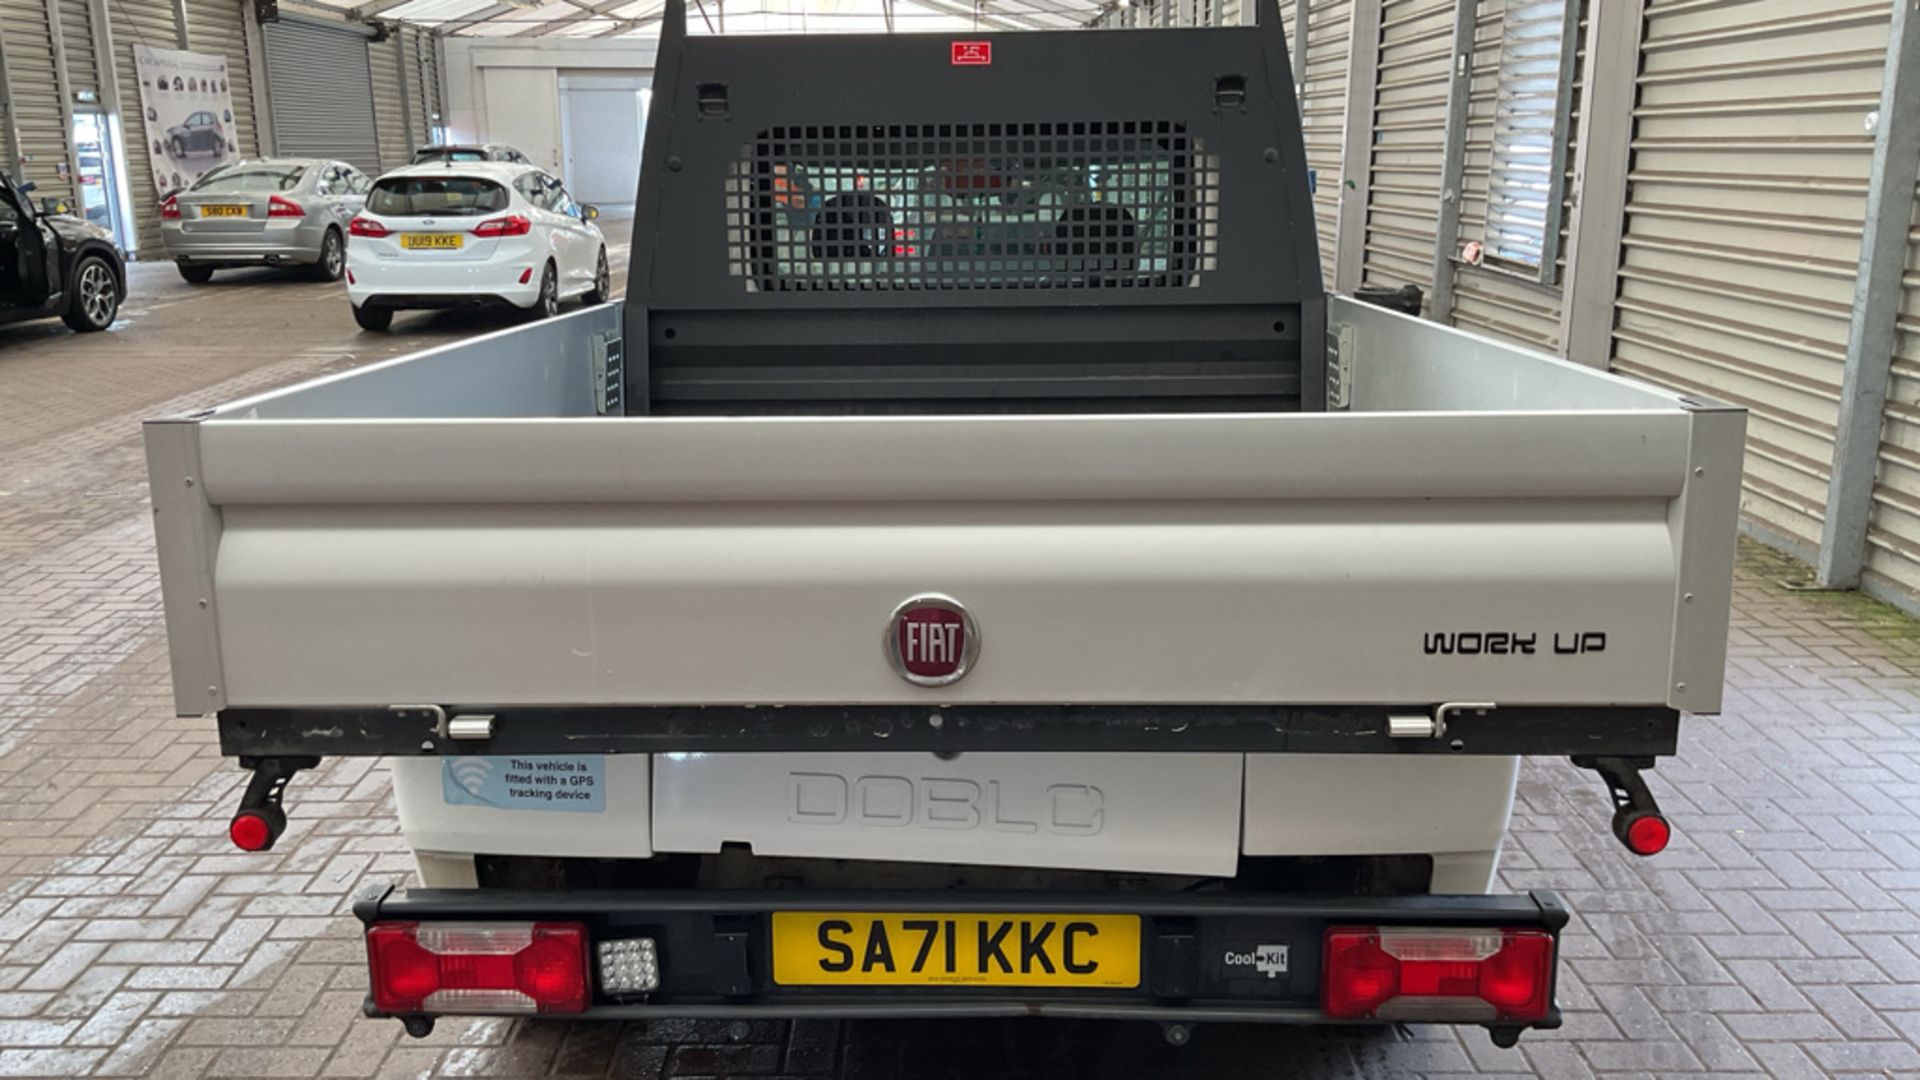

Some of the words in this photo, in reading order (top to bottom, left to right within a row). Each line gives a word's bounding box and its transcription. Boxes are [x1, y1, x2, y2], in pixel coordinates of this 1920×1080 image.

[435, 236, 456, 247] KKE
[907, 621, 960, 663] FIAT
[1424, 632, 1536, 655] WORK
[1554, 632, 1606, 655] UP
[510, 759, 533, 770] This
[536, 760, 575, 772] vehicle
[577, 761, 588, 772] is
[504, 773, 533, 785] fitted
[535, 774, 557, 786] with
[560, 778, 567, 786] a
[569, 775, 595, 787] GPS
[509, 788, 553, 801] tracking
[554, 789, 592, 800] device
[787, 771, 1105, 837] DOBLO
[816, 919, 957, 974] SA71
[976, 920, 1100, 975] KKC
